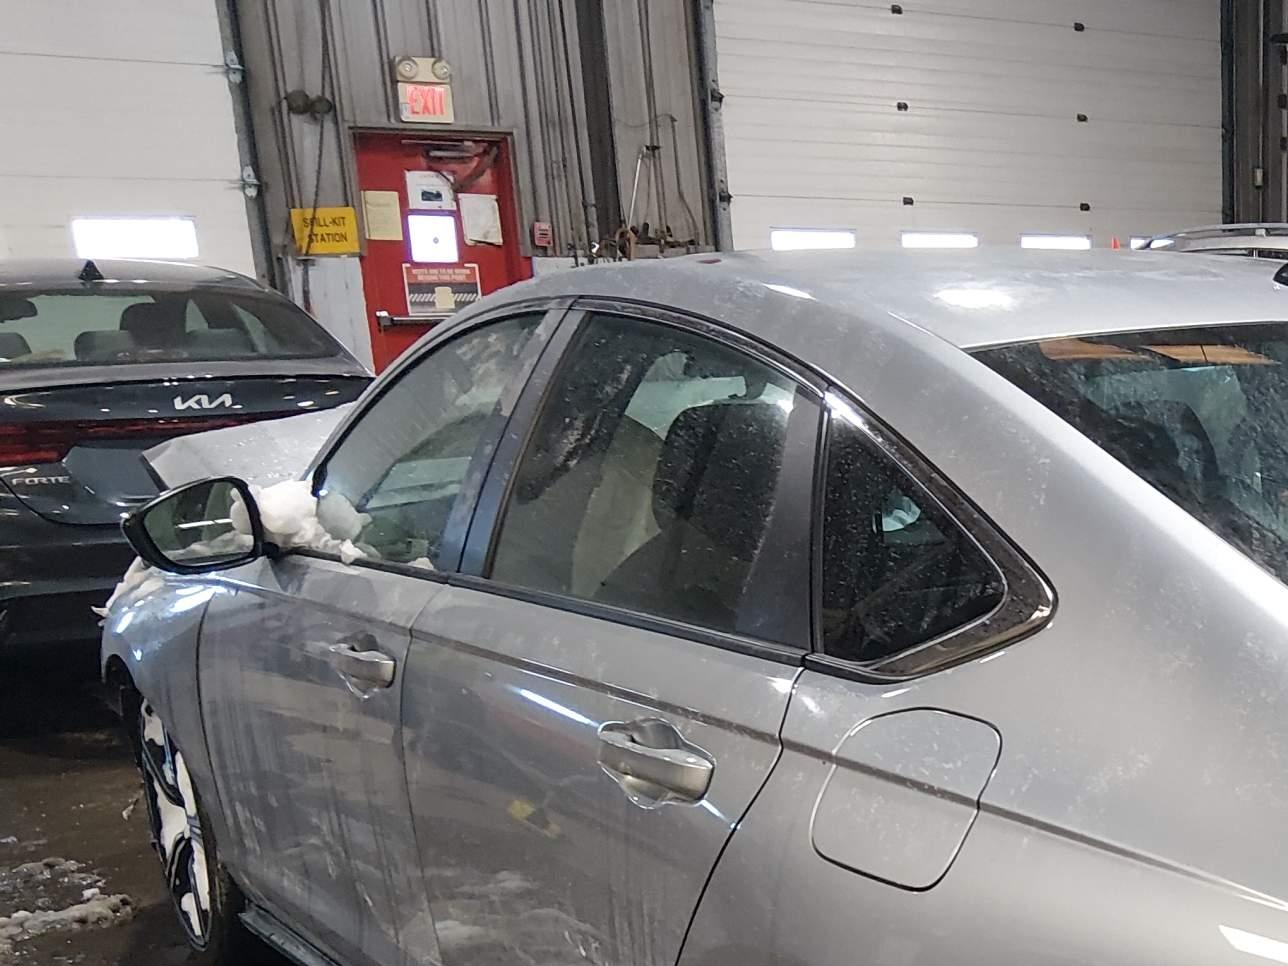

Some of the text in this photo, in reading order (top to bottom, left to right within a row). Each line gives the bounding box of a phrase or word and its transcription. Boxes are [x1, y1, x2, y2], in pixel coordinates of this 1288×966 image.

[408, 86, 446, 116] EXIT
[308, 232, 348, 243] STATION
[174, 393, 232, 410] KIA
[12, 476, 71, 486] FORTE
